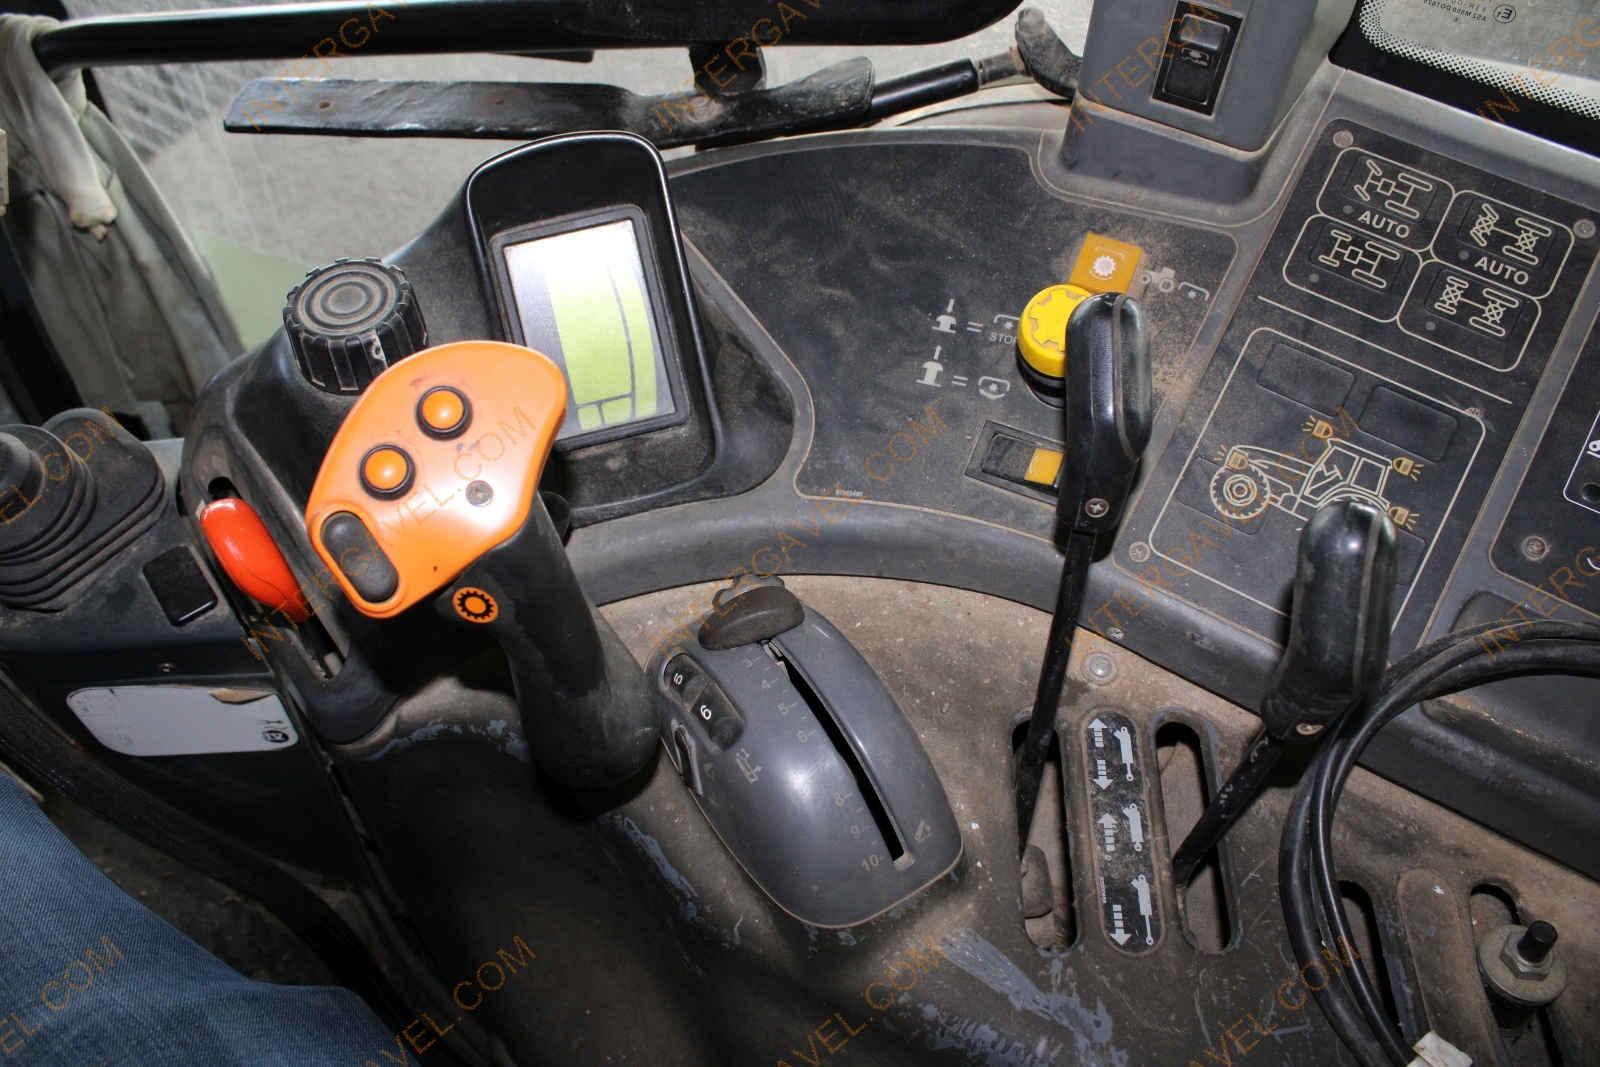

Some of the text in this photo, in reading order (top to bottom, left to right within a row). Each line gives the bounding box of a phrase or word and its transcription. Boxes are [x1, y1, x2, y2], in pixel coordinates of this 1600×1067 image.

[1357, 210, 1410, 239] AUTO
[1474, 256, 1529, 285] AUTO
[742, 659, 753, 668] 3
[673, 672, 683, 686] 5
[761, 679, 771, 689] 4
[700, 704, 712, 720] 6
[778, 702, 789, 716] 5
[796, 730, 808, 743] 6
[833, 792, 844, 807] 8
[850, 825, 861, 839] 9
[861, 854, 880, 871] 10
